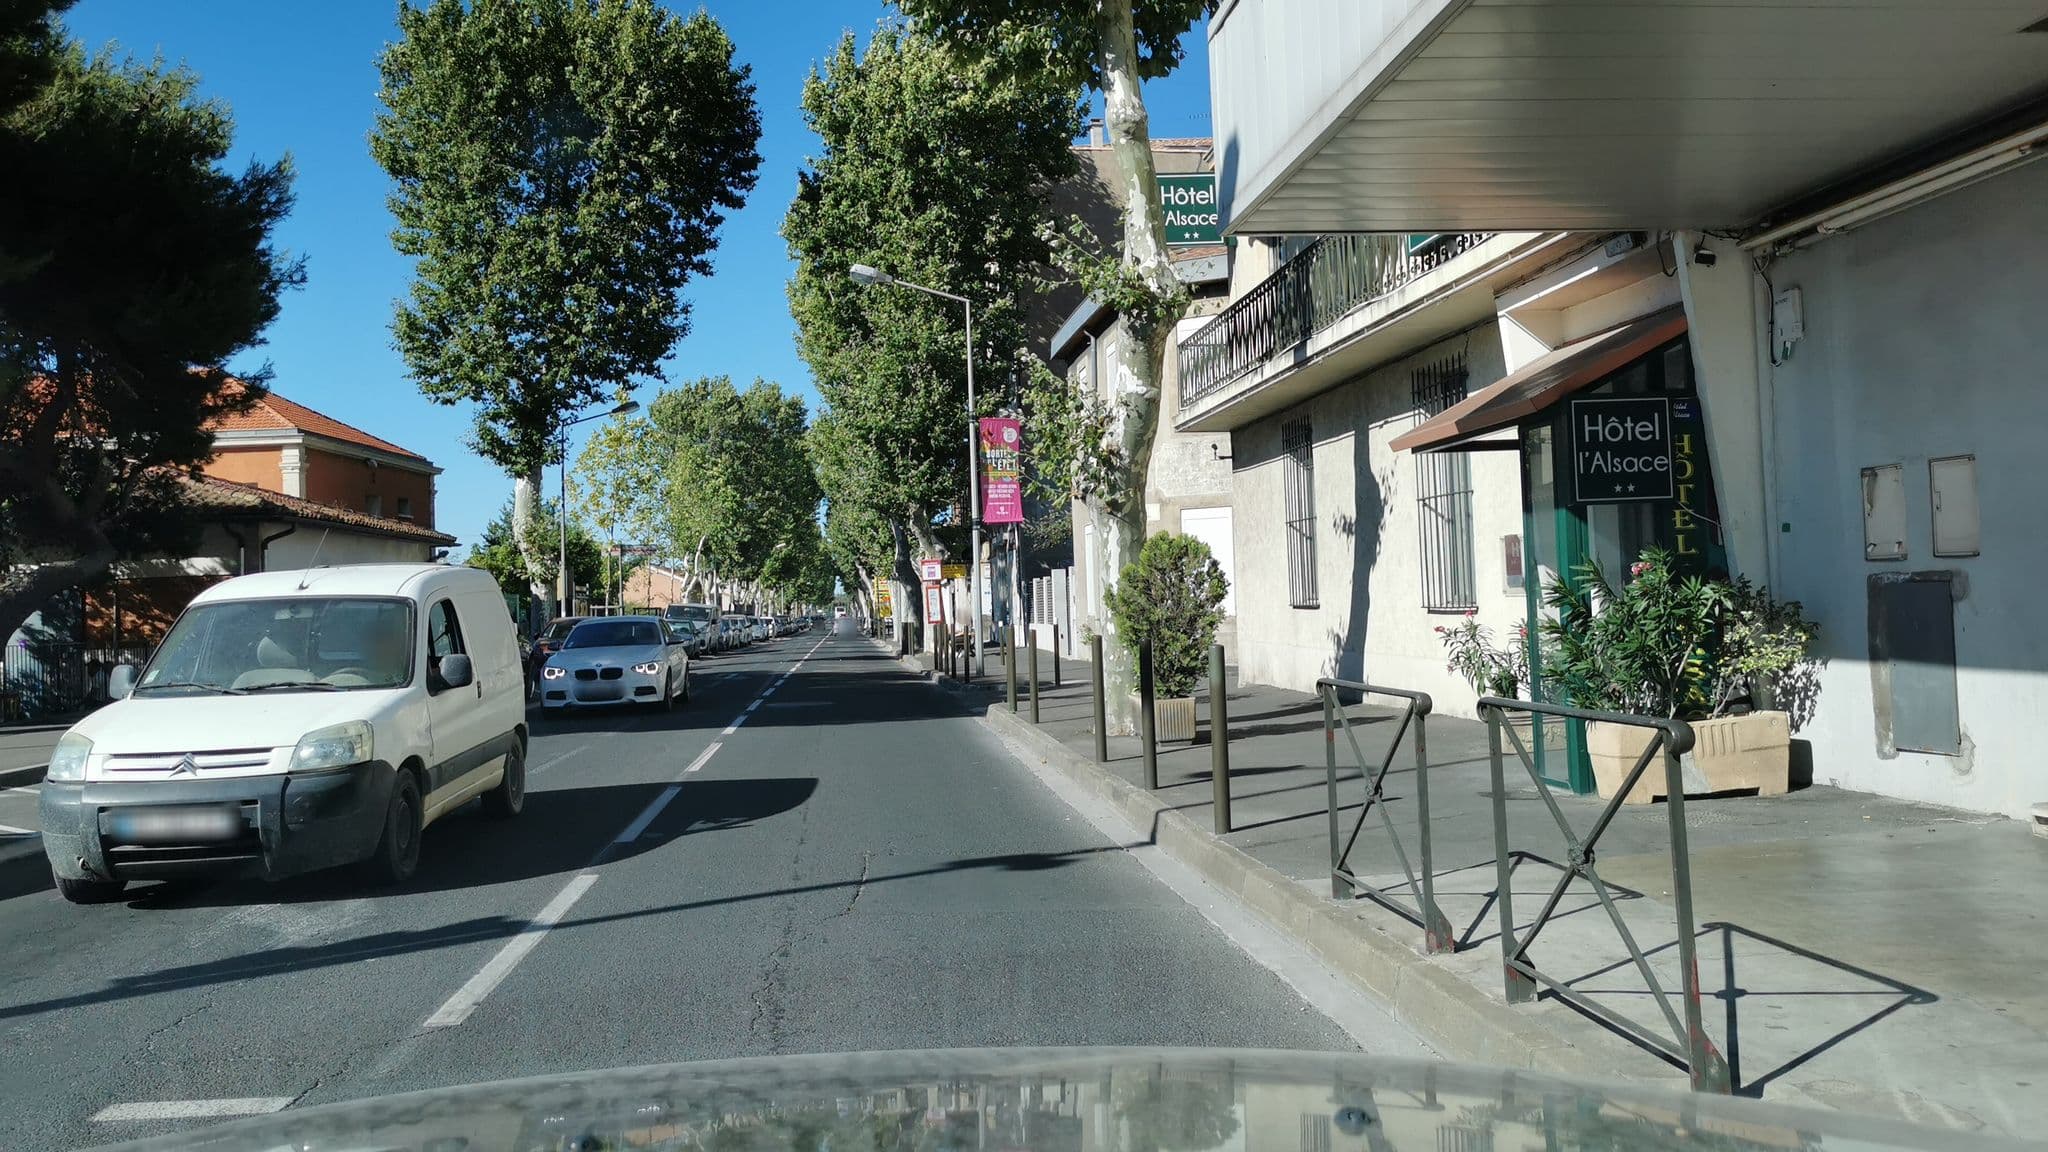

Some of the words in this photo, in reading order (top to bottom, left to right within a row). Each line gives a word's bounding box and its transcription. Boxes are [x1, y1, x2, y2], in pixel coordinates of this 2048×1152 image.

[1160, 184, 1214, 206] Hôtel
[1162, 209, 1219, 227] 'Alsace
[1583, 411, 1660, 443] Hôtel
[1578, 449, 1668, 475] l'Alsace
